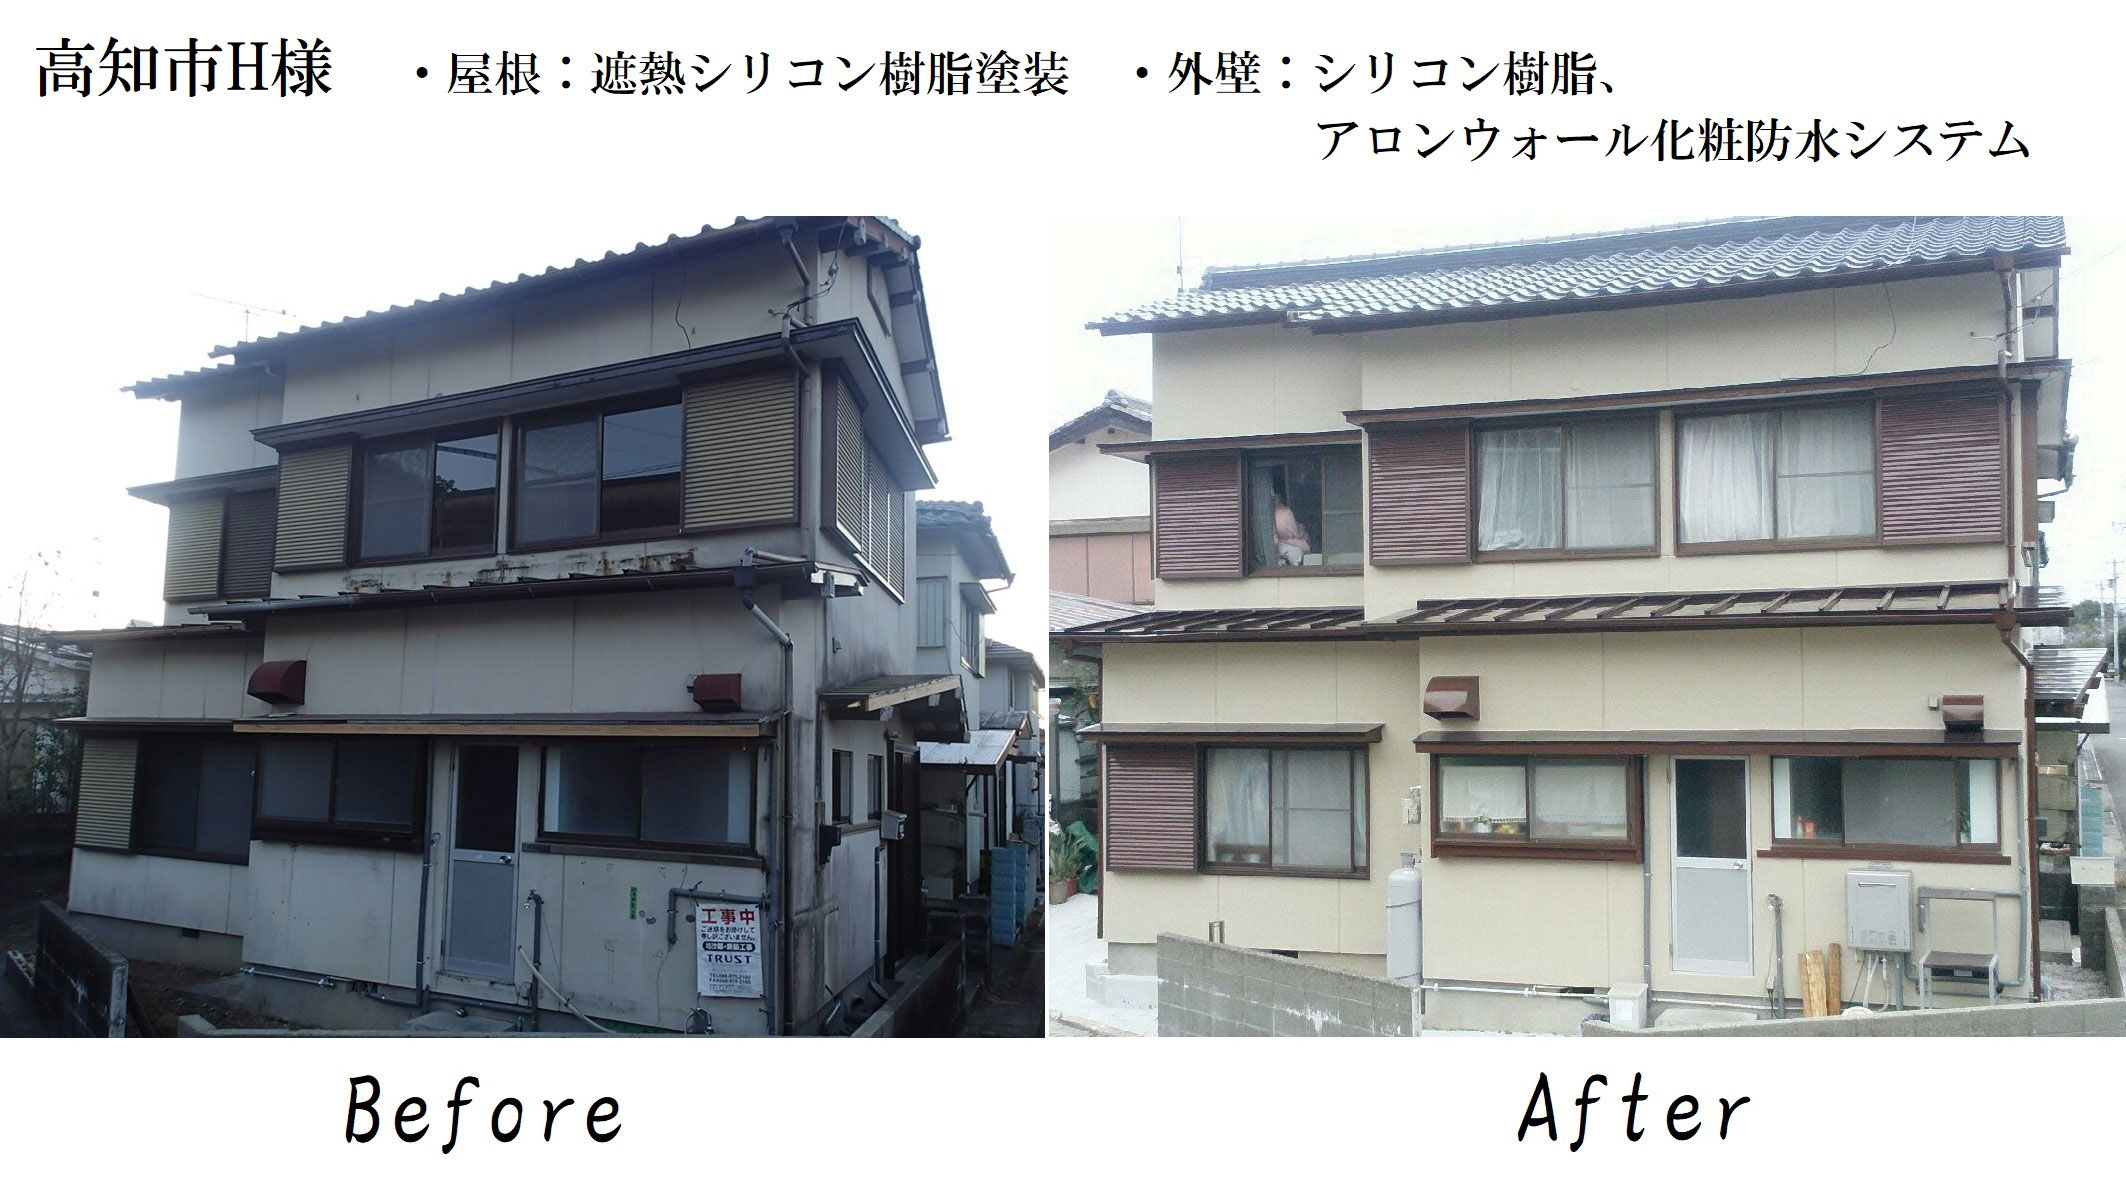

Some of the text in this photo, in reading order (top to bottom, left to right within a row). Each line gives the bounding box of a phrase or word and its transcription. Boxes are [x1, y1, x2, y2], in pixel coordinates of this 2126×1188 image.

[701, 908, 755, 925] 工事中
[707, 954, 751, 964] TRUST
